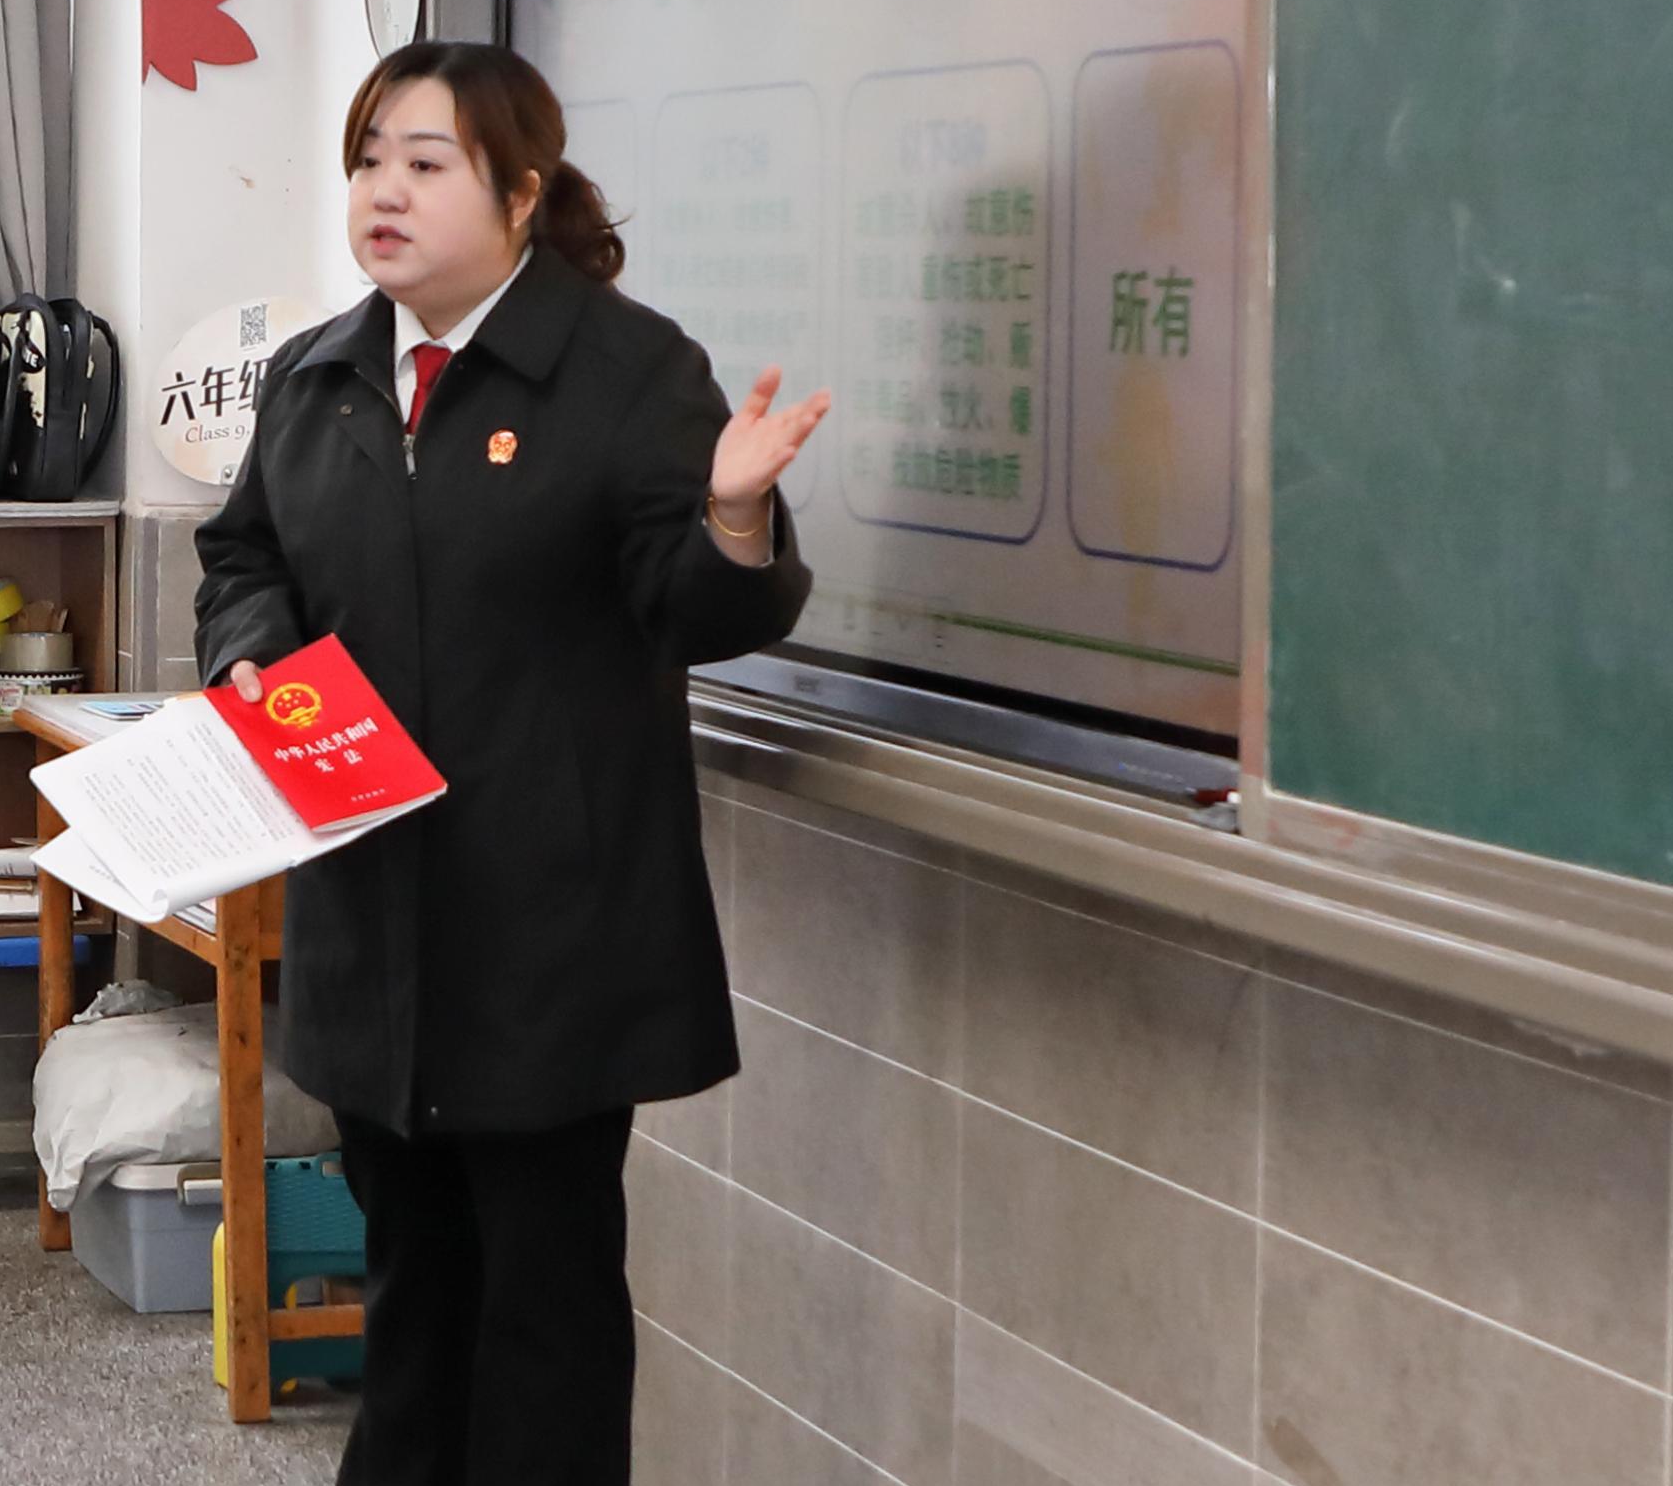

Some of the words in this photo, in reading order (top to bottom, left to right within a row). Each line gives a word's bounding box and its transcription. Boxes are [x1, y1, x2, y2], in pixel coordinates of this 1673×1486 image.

[1108, 268, 1196, 361] 所有
[184, 425, 230, 444] Class
[274, 717, 379, 763] 中华人民共和国
